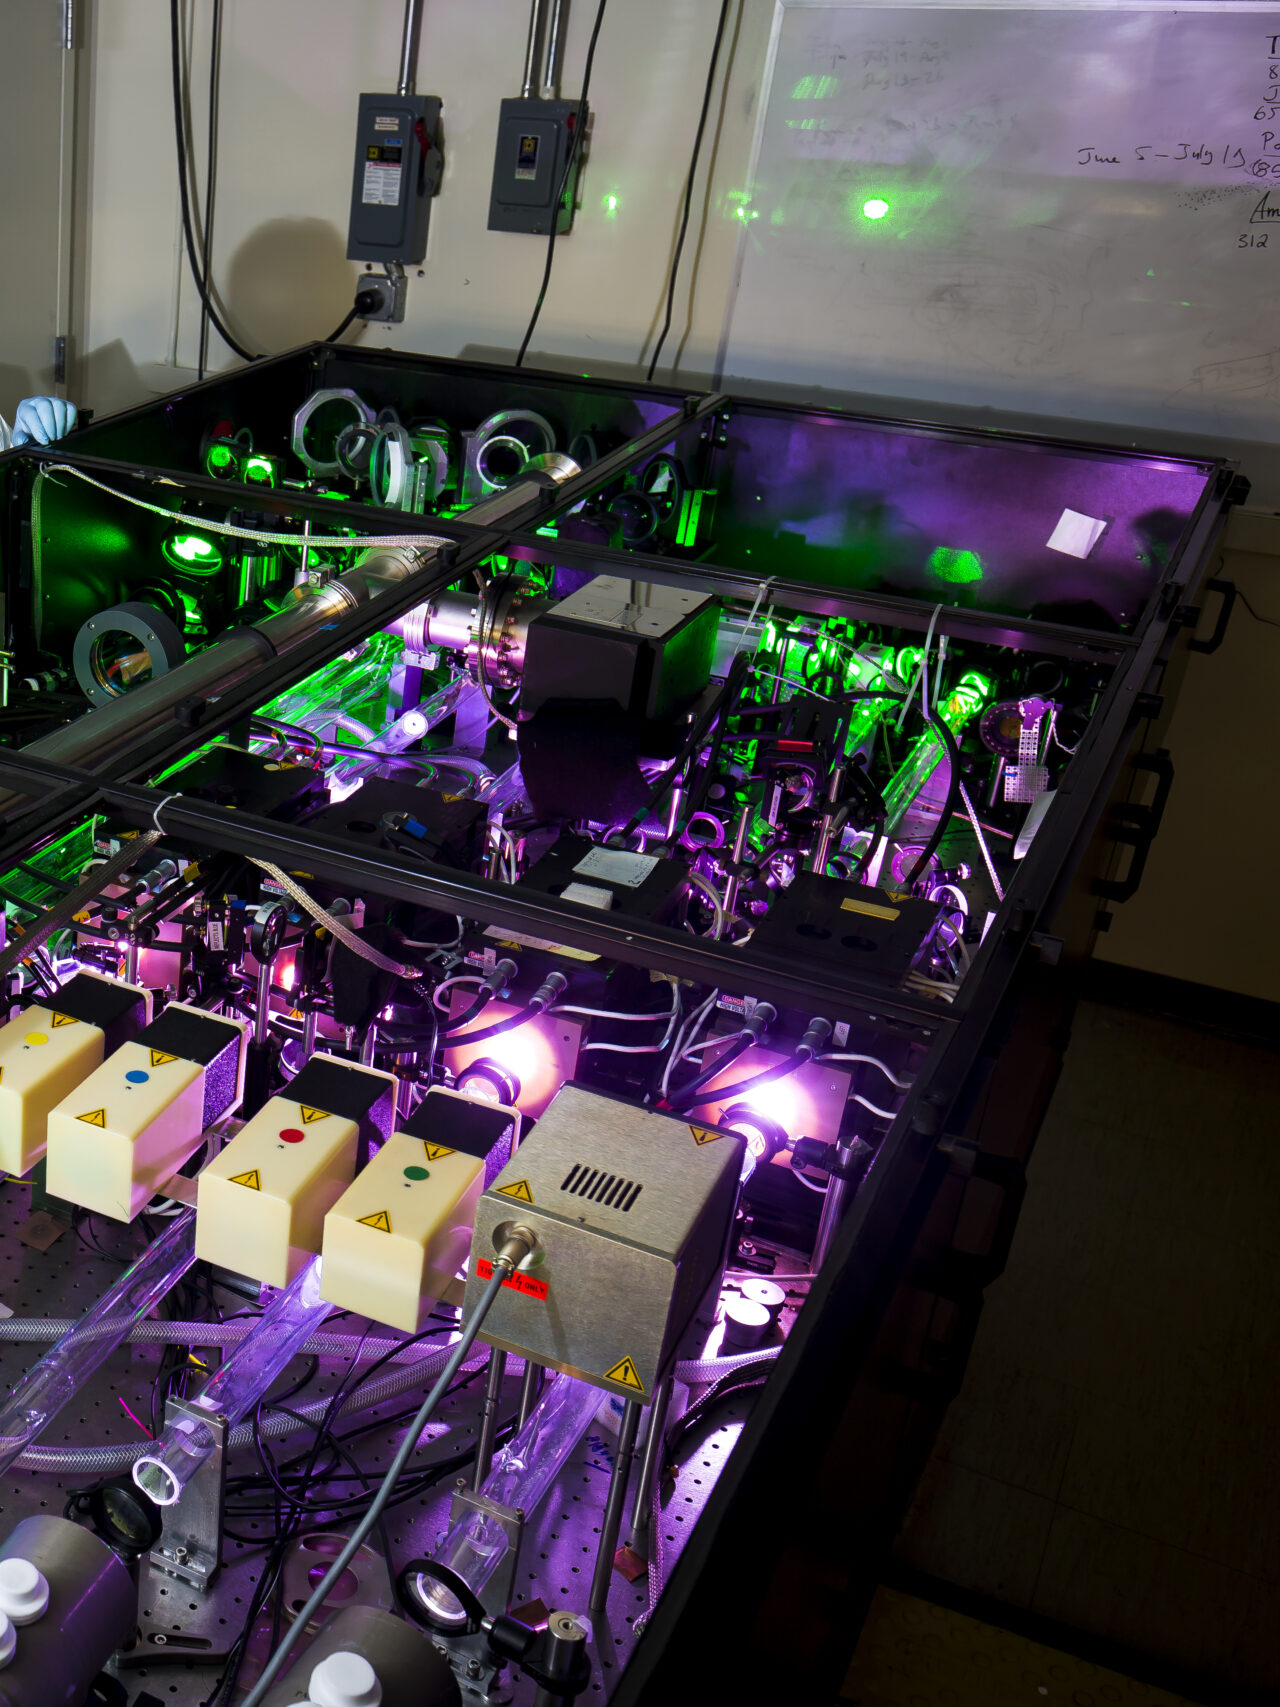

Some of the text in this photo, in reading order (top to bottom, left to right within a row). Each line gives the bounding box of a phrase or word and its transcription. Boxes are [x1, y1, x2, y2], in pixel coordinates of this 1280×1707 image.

[1078, 147, 1121, 165] June
[1174, 143, 1214, 166] July
[1238, 233, 1269, 249] 312
[524, 1282, 545, 1295] ONLY
